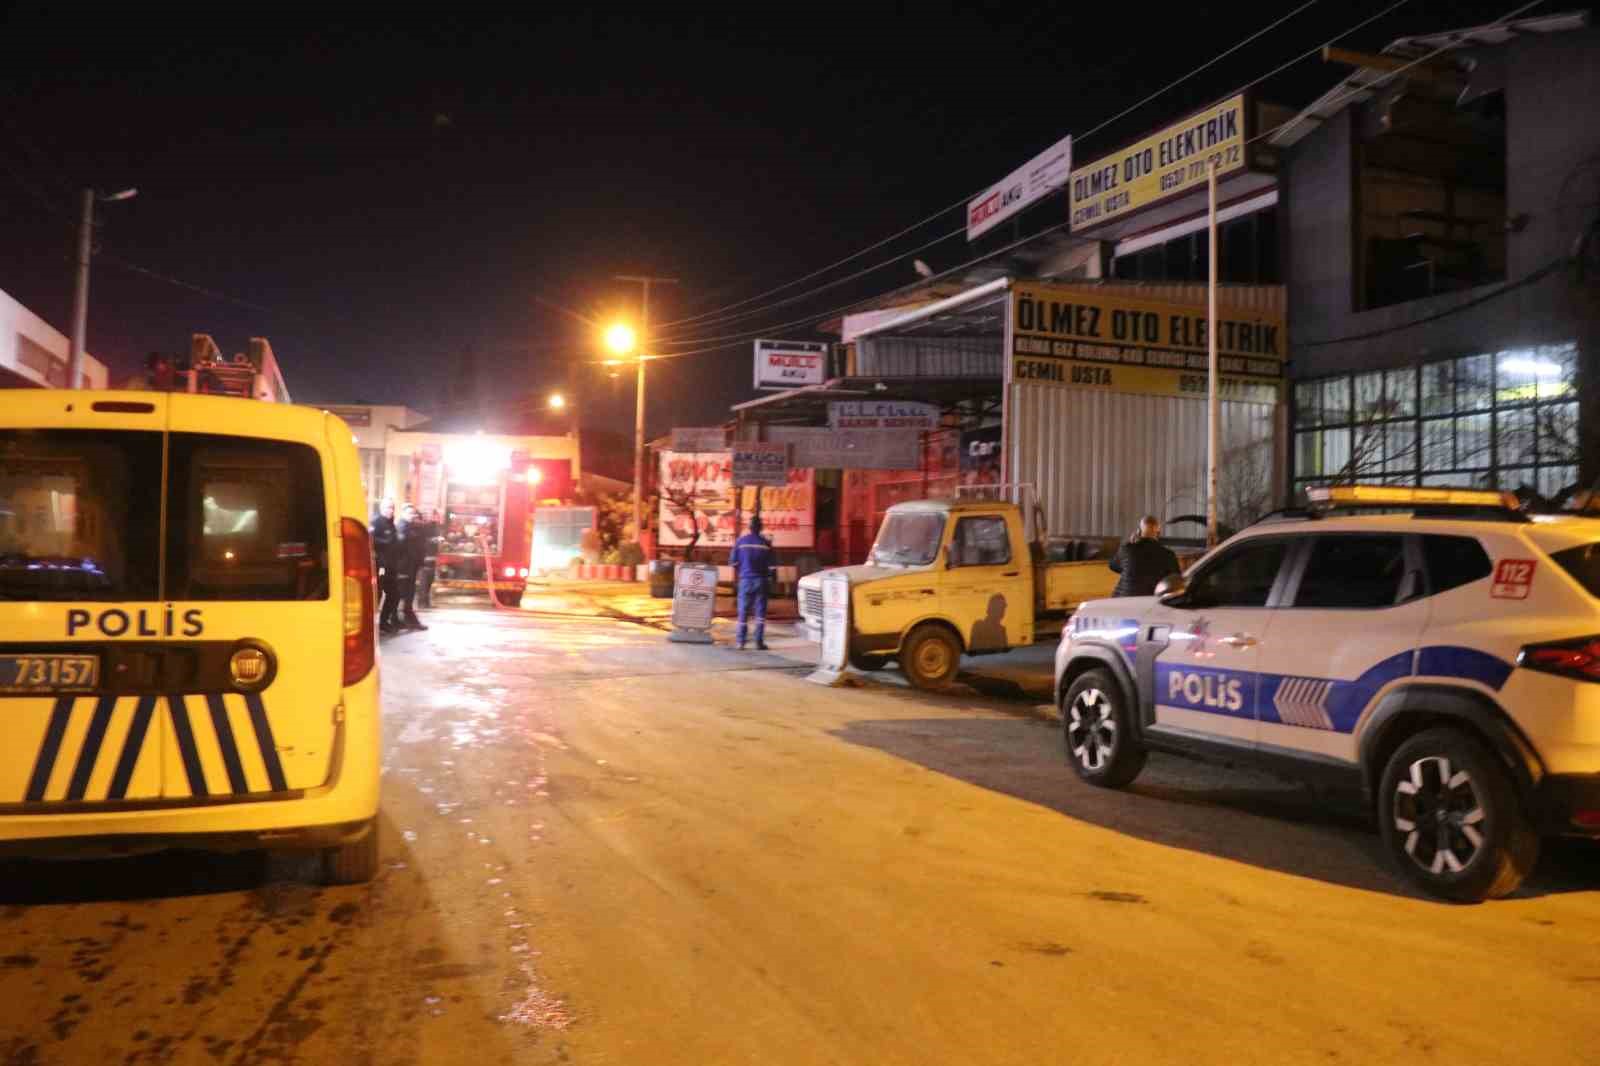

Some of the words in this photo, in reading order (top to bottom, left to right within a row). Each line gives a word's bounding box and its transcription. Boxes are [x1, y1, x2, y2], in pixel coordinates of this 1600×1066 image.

[1074, 163, 1119, 203] ÖLMEZ
[1123, 147, 1153, 183] OTO
[1159, 107, 1237, 168] ELEKTRİK
[1017, 291, 1101, 337] ÖLMEZ
[1111, 309, 1160, 342] OTO
[1016, 359, 1065, 382] CEMİL
[1071, 365, 1113, 385] USTA
[1502, 563, 1531, 583] 112
[66, 603, 205, 637] POLİS
[15, 658, 93, 685] 73157
[1168, 670, 1243, 711] POLİS
